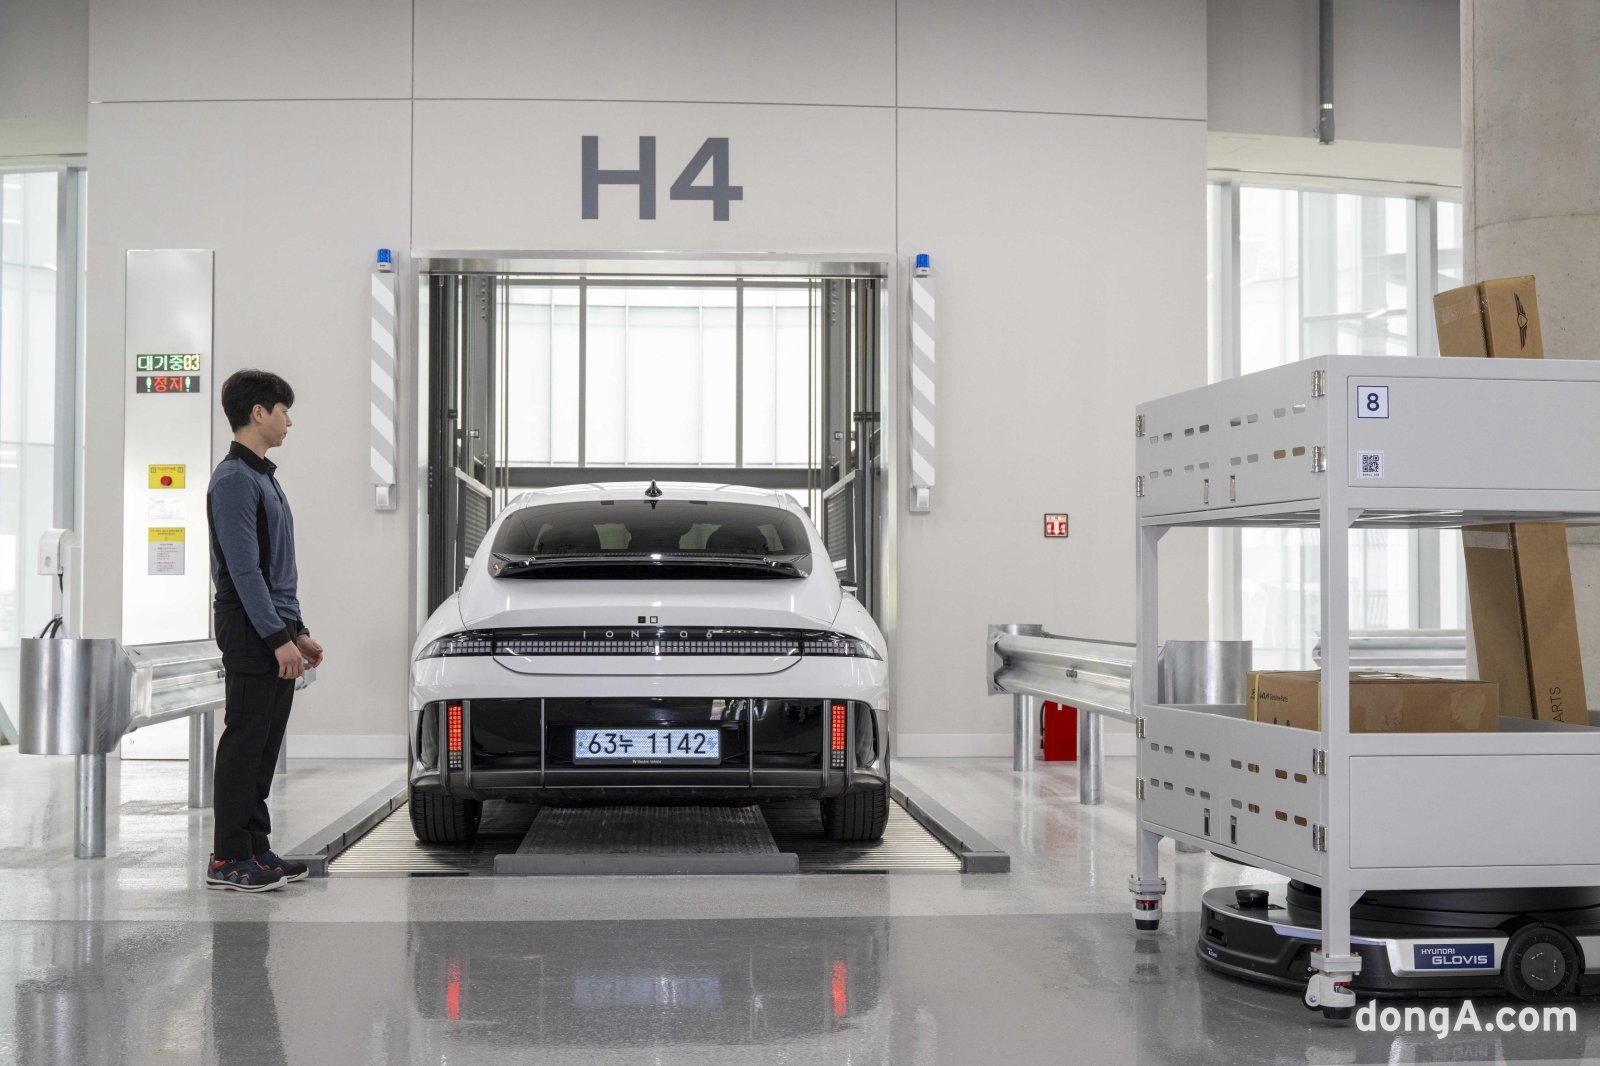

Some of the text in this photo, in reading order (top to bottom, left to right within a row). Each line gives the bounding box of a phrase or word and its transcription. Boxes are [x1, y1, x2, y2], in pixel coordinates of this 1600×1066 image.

[581, 135, 744, 221] H4
[1366, 392, 1380, 412] 8
[1549, 686, 1565, 723] ARTS
[588, 733, 706, 754] 63누 1142
[1432, 955, 1488, 965] GLOVIS
